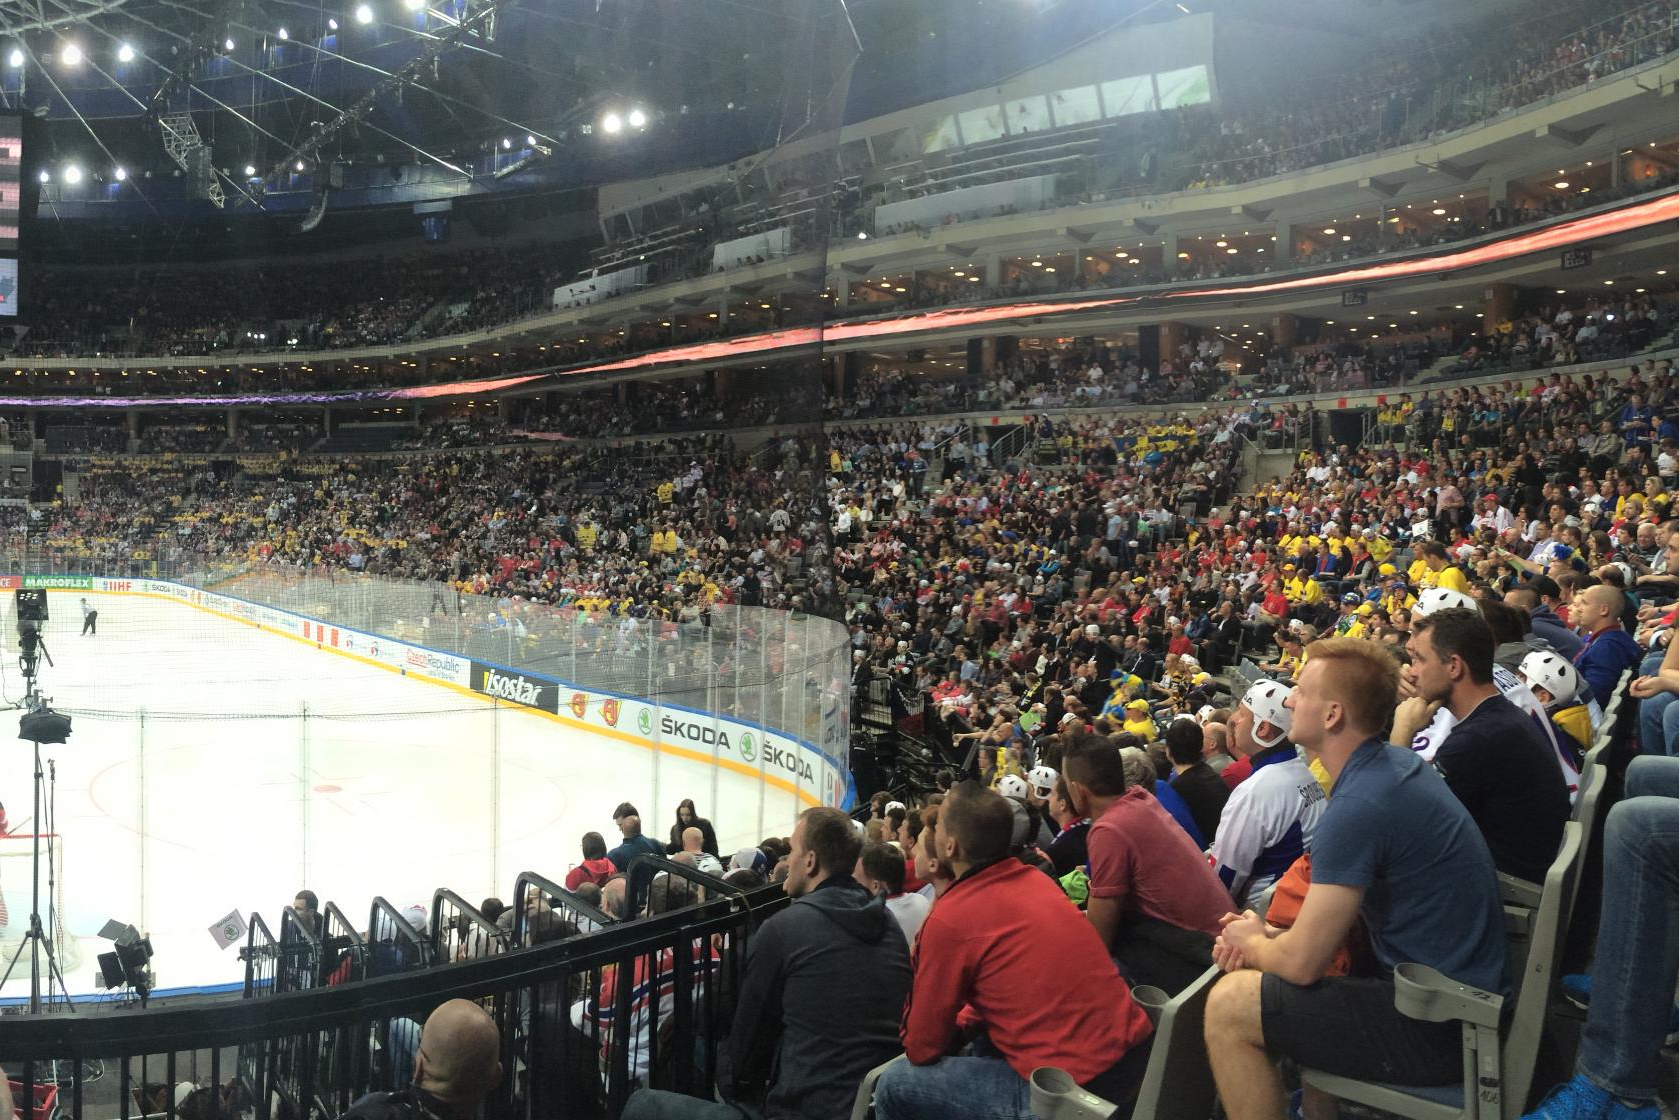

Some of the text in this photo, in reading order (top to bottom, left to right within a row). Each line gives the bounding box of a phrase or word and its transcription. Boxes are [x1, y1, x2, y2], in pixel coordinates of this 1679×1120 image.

[25, 577, 89, 588] MAKROFLEX
[109, 581, 132, 592] IIHF
[485, 668, 543, 707] isostar
[661, 714, 731, 750] ŠKODA
[762, 739, 815, 785] ŠKODA
